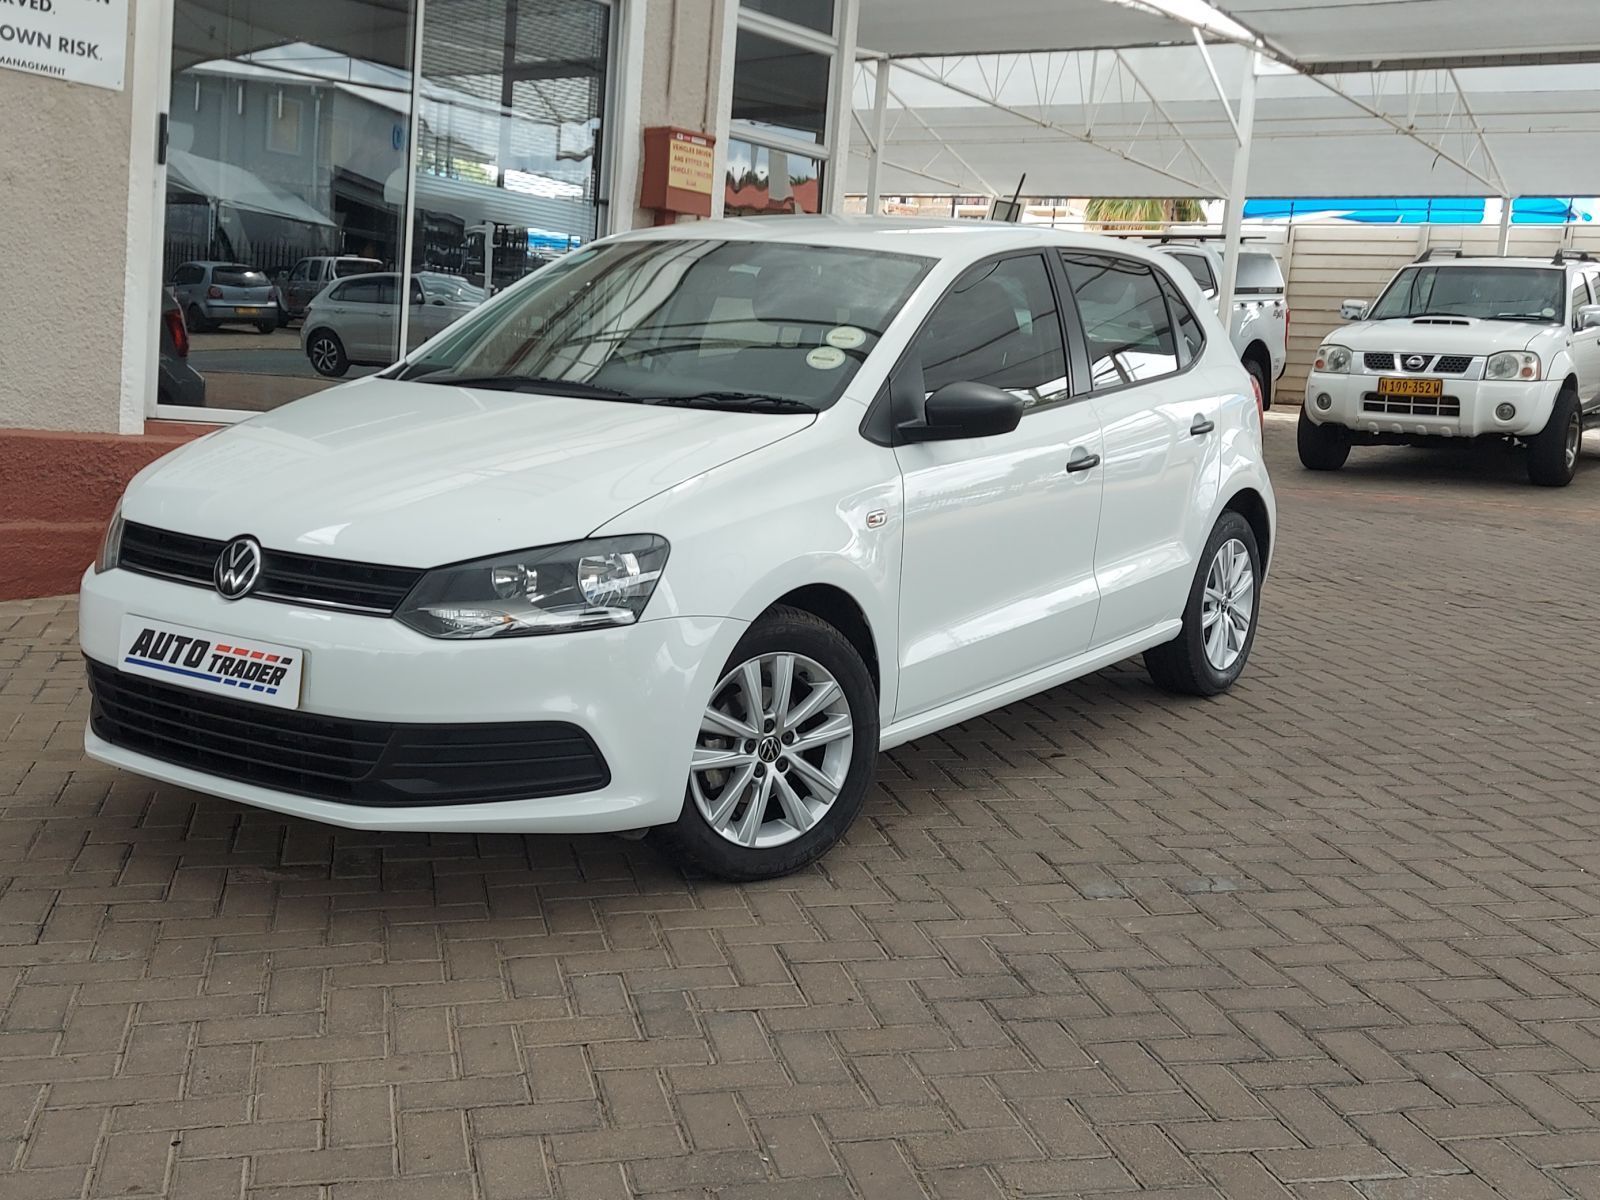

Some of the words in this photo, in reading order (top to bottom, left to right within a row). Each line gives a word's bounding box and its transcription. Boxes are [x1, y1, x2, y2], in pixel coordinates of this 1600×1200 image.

[0, 24, 52, 50] OWN
[58, 36, 103, 62] RISK.
[1381, 381, 1387, 392] N
[128, 628, 211, 669] AUTO
[207, 653, 288, 687] TRADER
